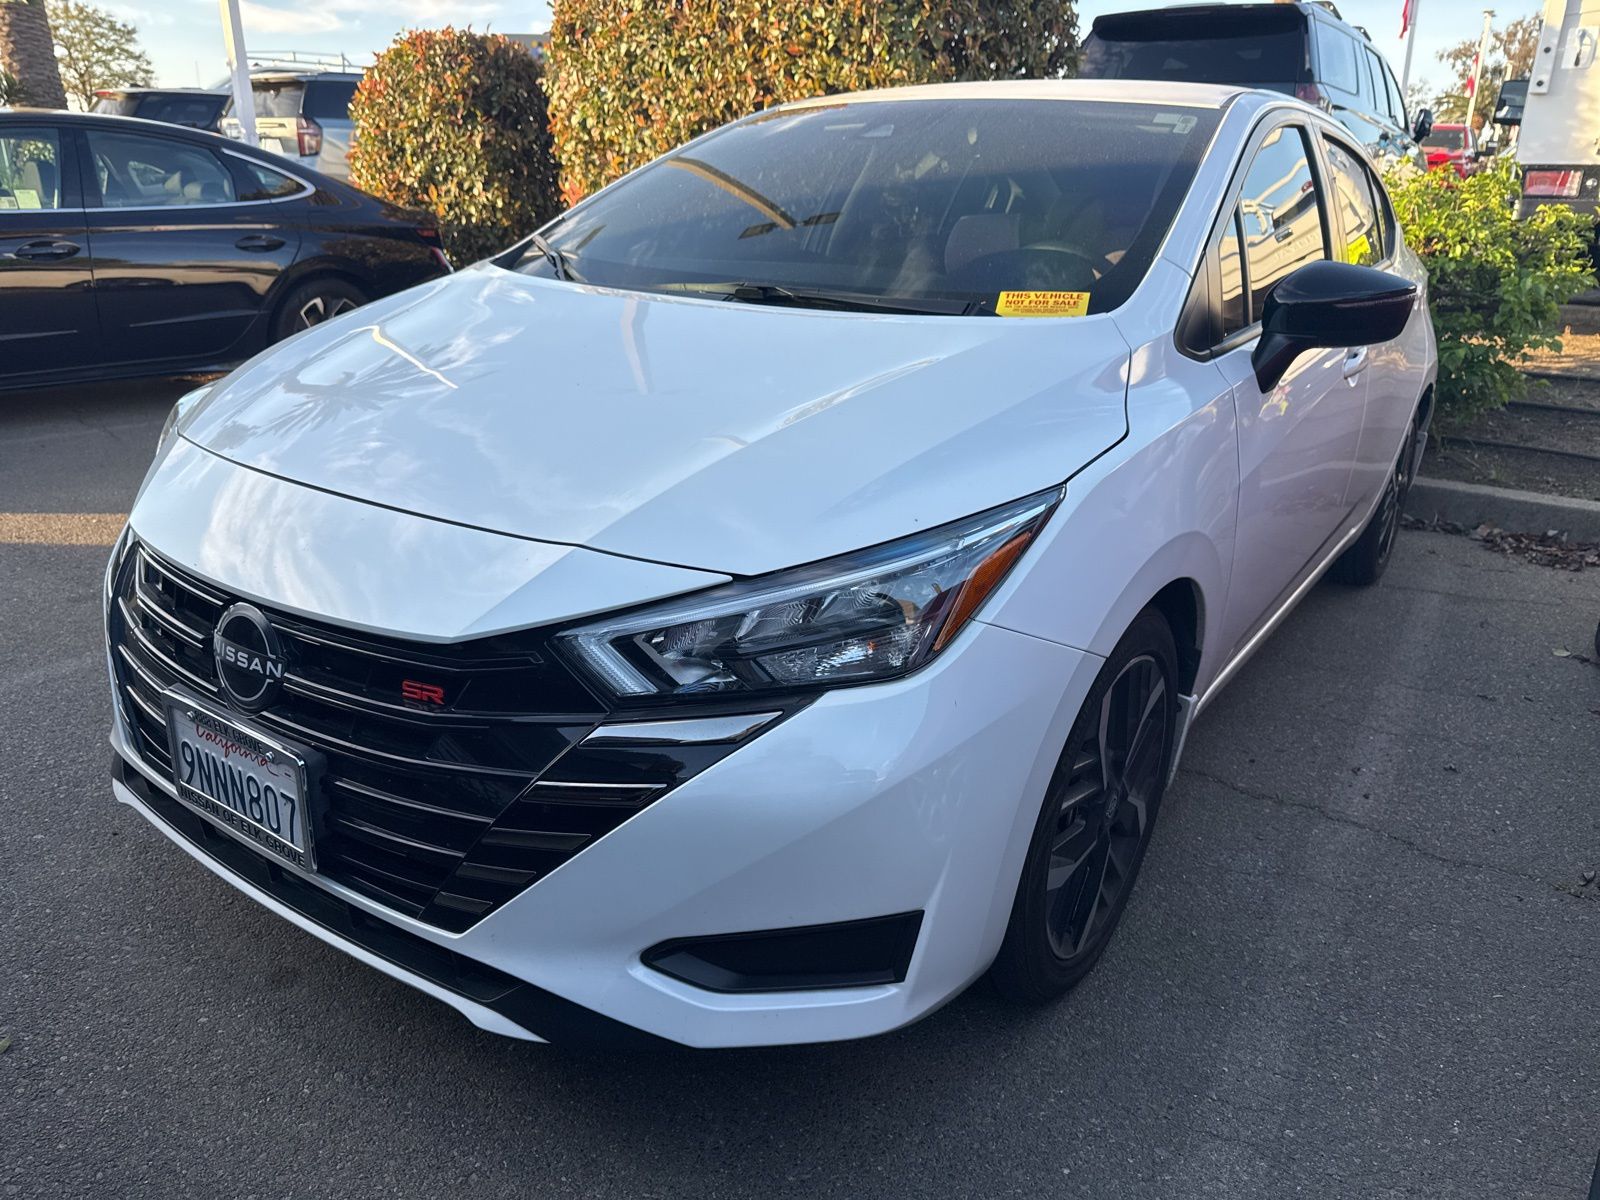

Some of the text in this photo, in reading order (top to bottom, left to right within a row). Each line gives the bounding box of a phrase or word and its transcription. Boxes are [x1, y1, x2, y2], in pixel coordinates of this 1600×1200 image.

[213, 630, 284, 679] NISSAN
[401, 679, 445, 705] SR
[232, 729, 263, 754] GROVE
[181, 739, 297, 845] 9NNN807
[180, 785, 306, 867] NISSAN OF ELK GROVE
